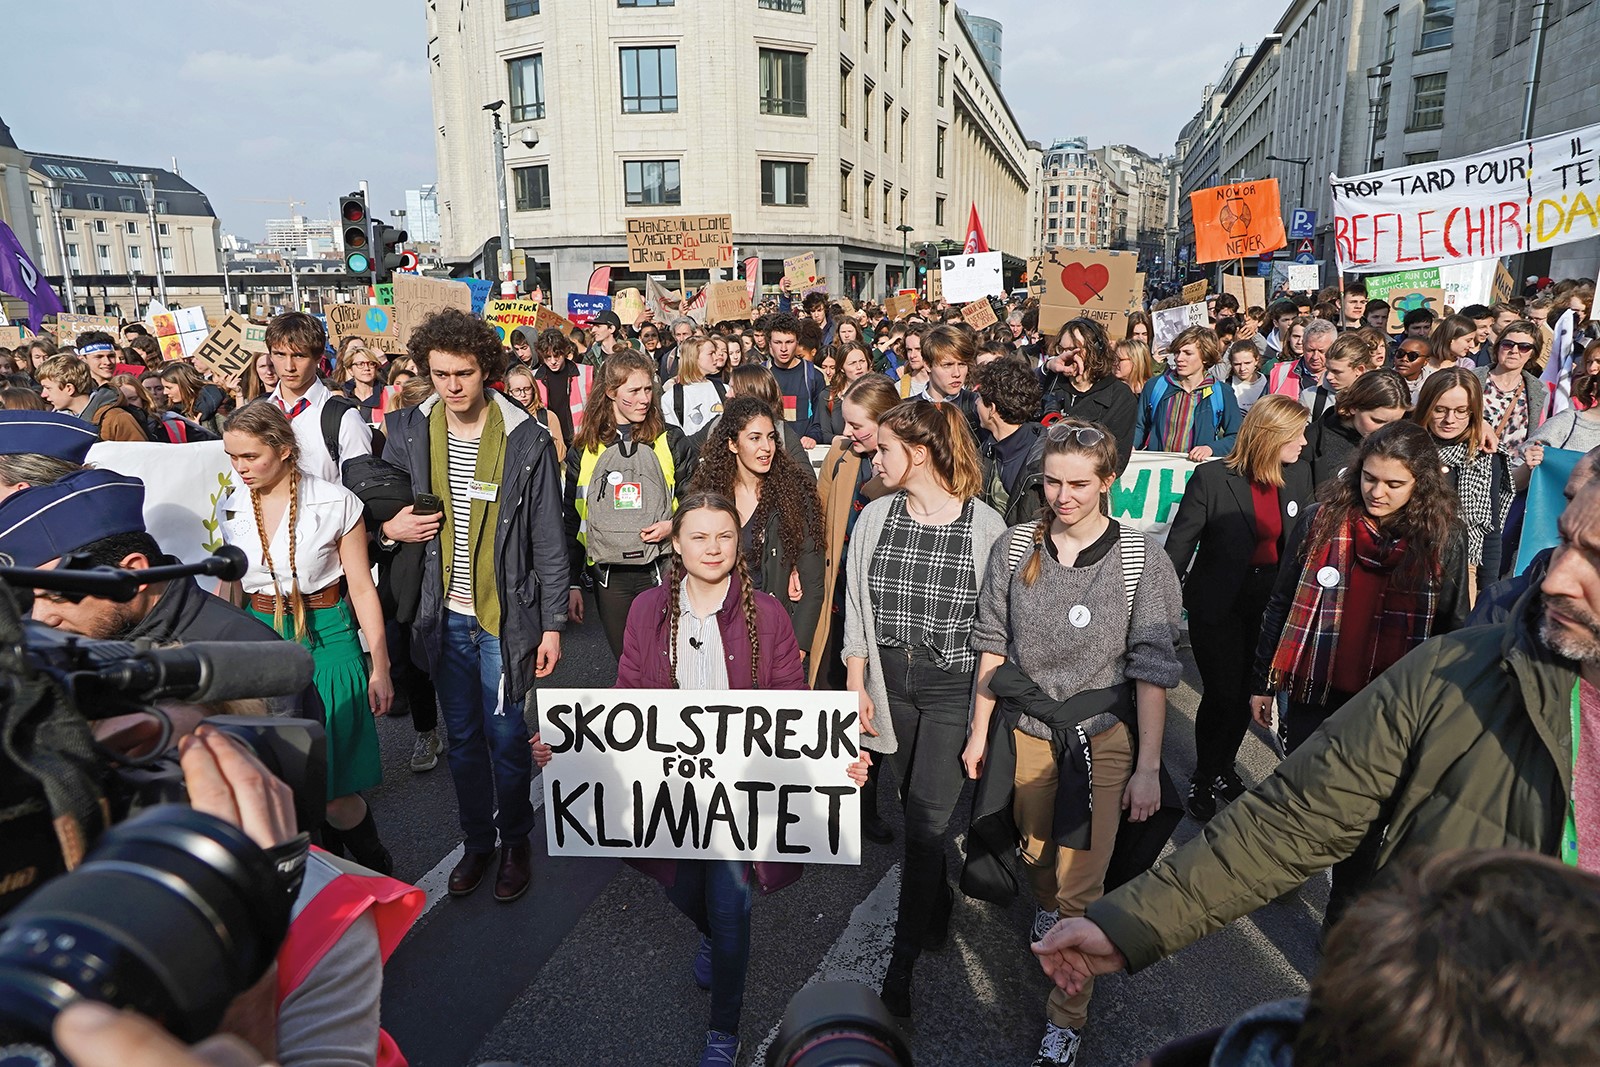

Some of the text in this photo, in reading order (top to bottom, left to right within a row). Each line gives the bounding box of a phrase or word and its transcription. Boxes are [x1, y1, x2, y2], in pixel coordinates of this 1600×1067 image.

[1571, 137, 1594, 159] IL
[1331, 157, 1526, 200] TROP TARD POUR
[1552, 158, 1600, 190] TE
[1217, 184, 1256, 201] NOW OR
[698, 217, 730, 231] COME
[1293, 211, 1308, 230] P
[1536, 191, 1600, 243] D'A
[634, 233, 682, 246] WHETHER
[1335, 201, 1523, 265] REFLECHIR
[1226, 234, 1265, 256] NEVER
[632, 248, 648, 263] OR
[1369, 269, 1438, 287] WE HAVE RUN OUT
[519, 303, 537, 312] FUCK
[1080, 309, 1117, 321] PLANET
[60, 314, 101, 323] RESPECT
[497, 314, 535, 326] MOTHER
[199, 315, 242, 364] ACT
[546, 702, 859, 759] SKOLSTREJK
[662, 753, 716, 779] FÖR
[552, 779, 857, 855] KLIMATET
